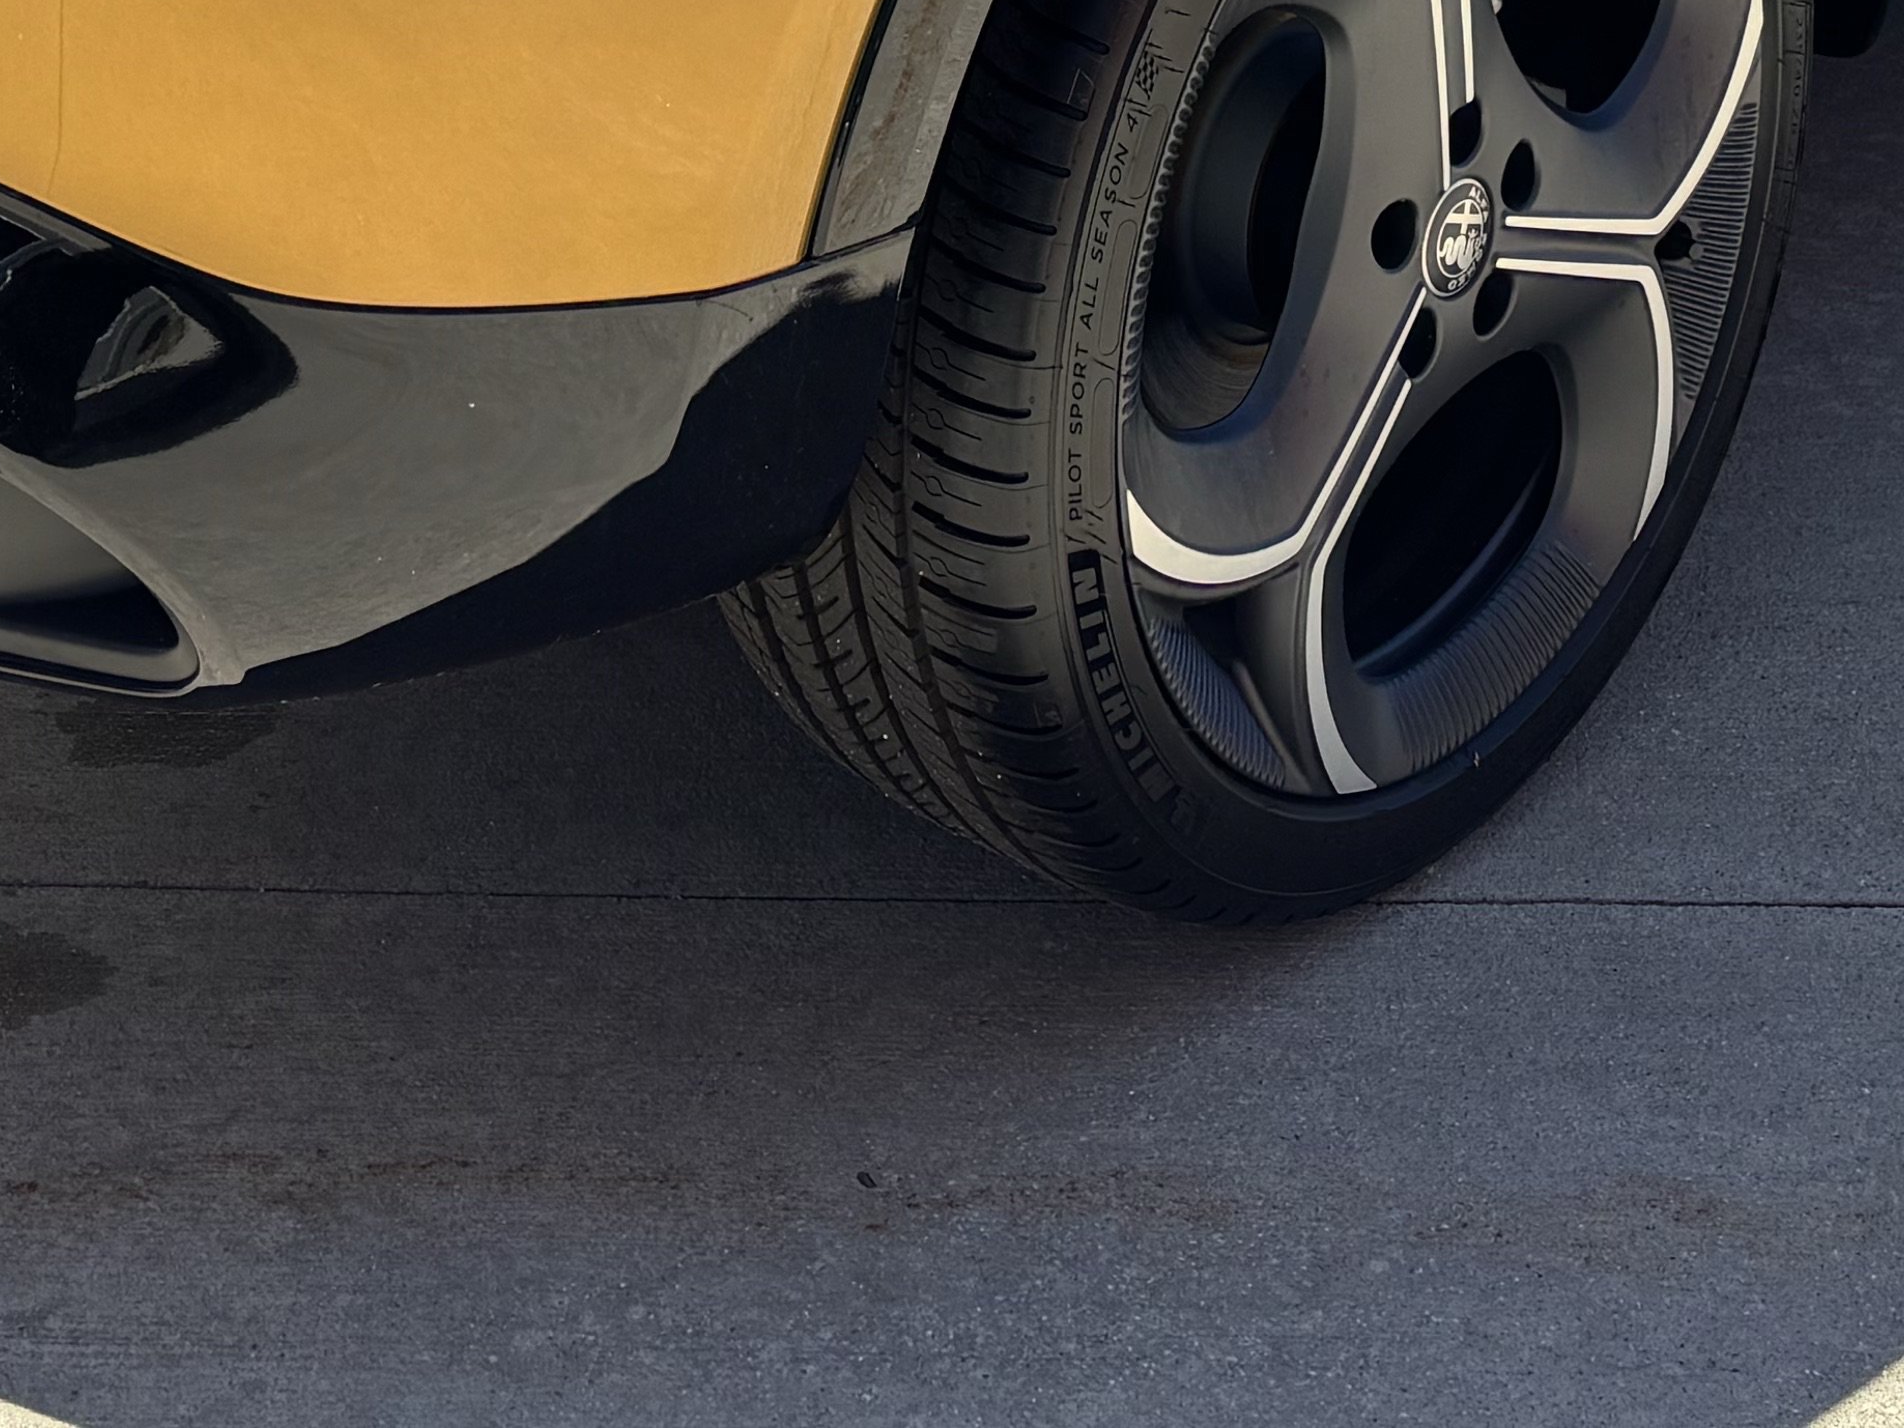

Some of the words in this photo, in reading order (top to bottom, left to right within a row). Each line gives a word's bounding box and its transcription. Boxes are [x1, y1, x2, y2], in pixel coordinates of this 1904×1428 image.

[1125, 111, 1138, 134] 4
[1091, 141, 1130, 265] SEASON
[1078, 276, 1101, 331] ALL
[1069, 342, 1090, 437] SPORT
[1067, 448, 1085, 522] PILOT
[1070, 566, 1177, 804] MICHELIN
